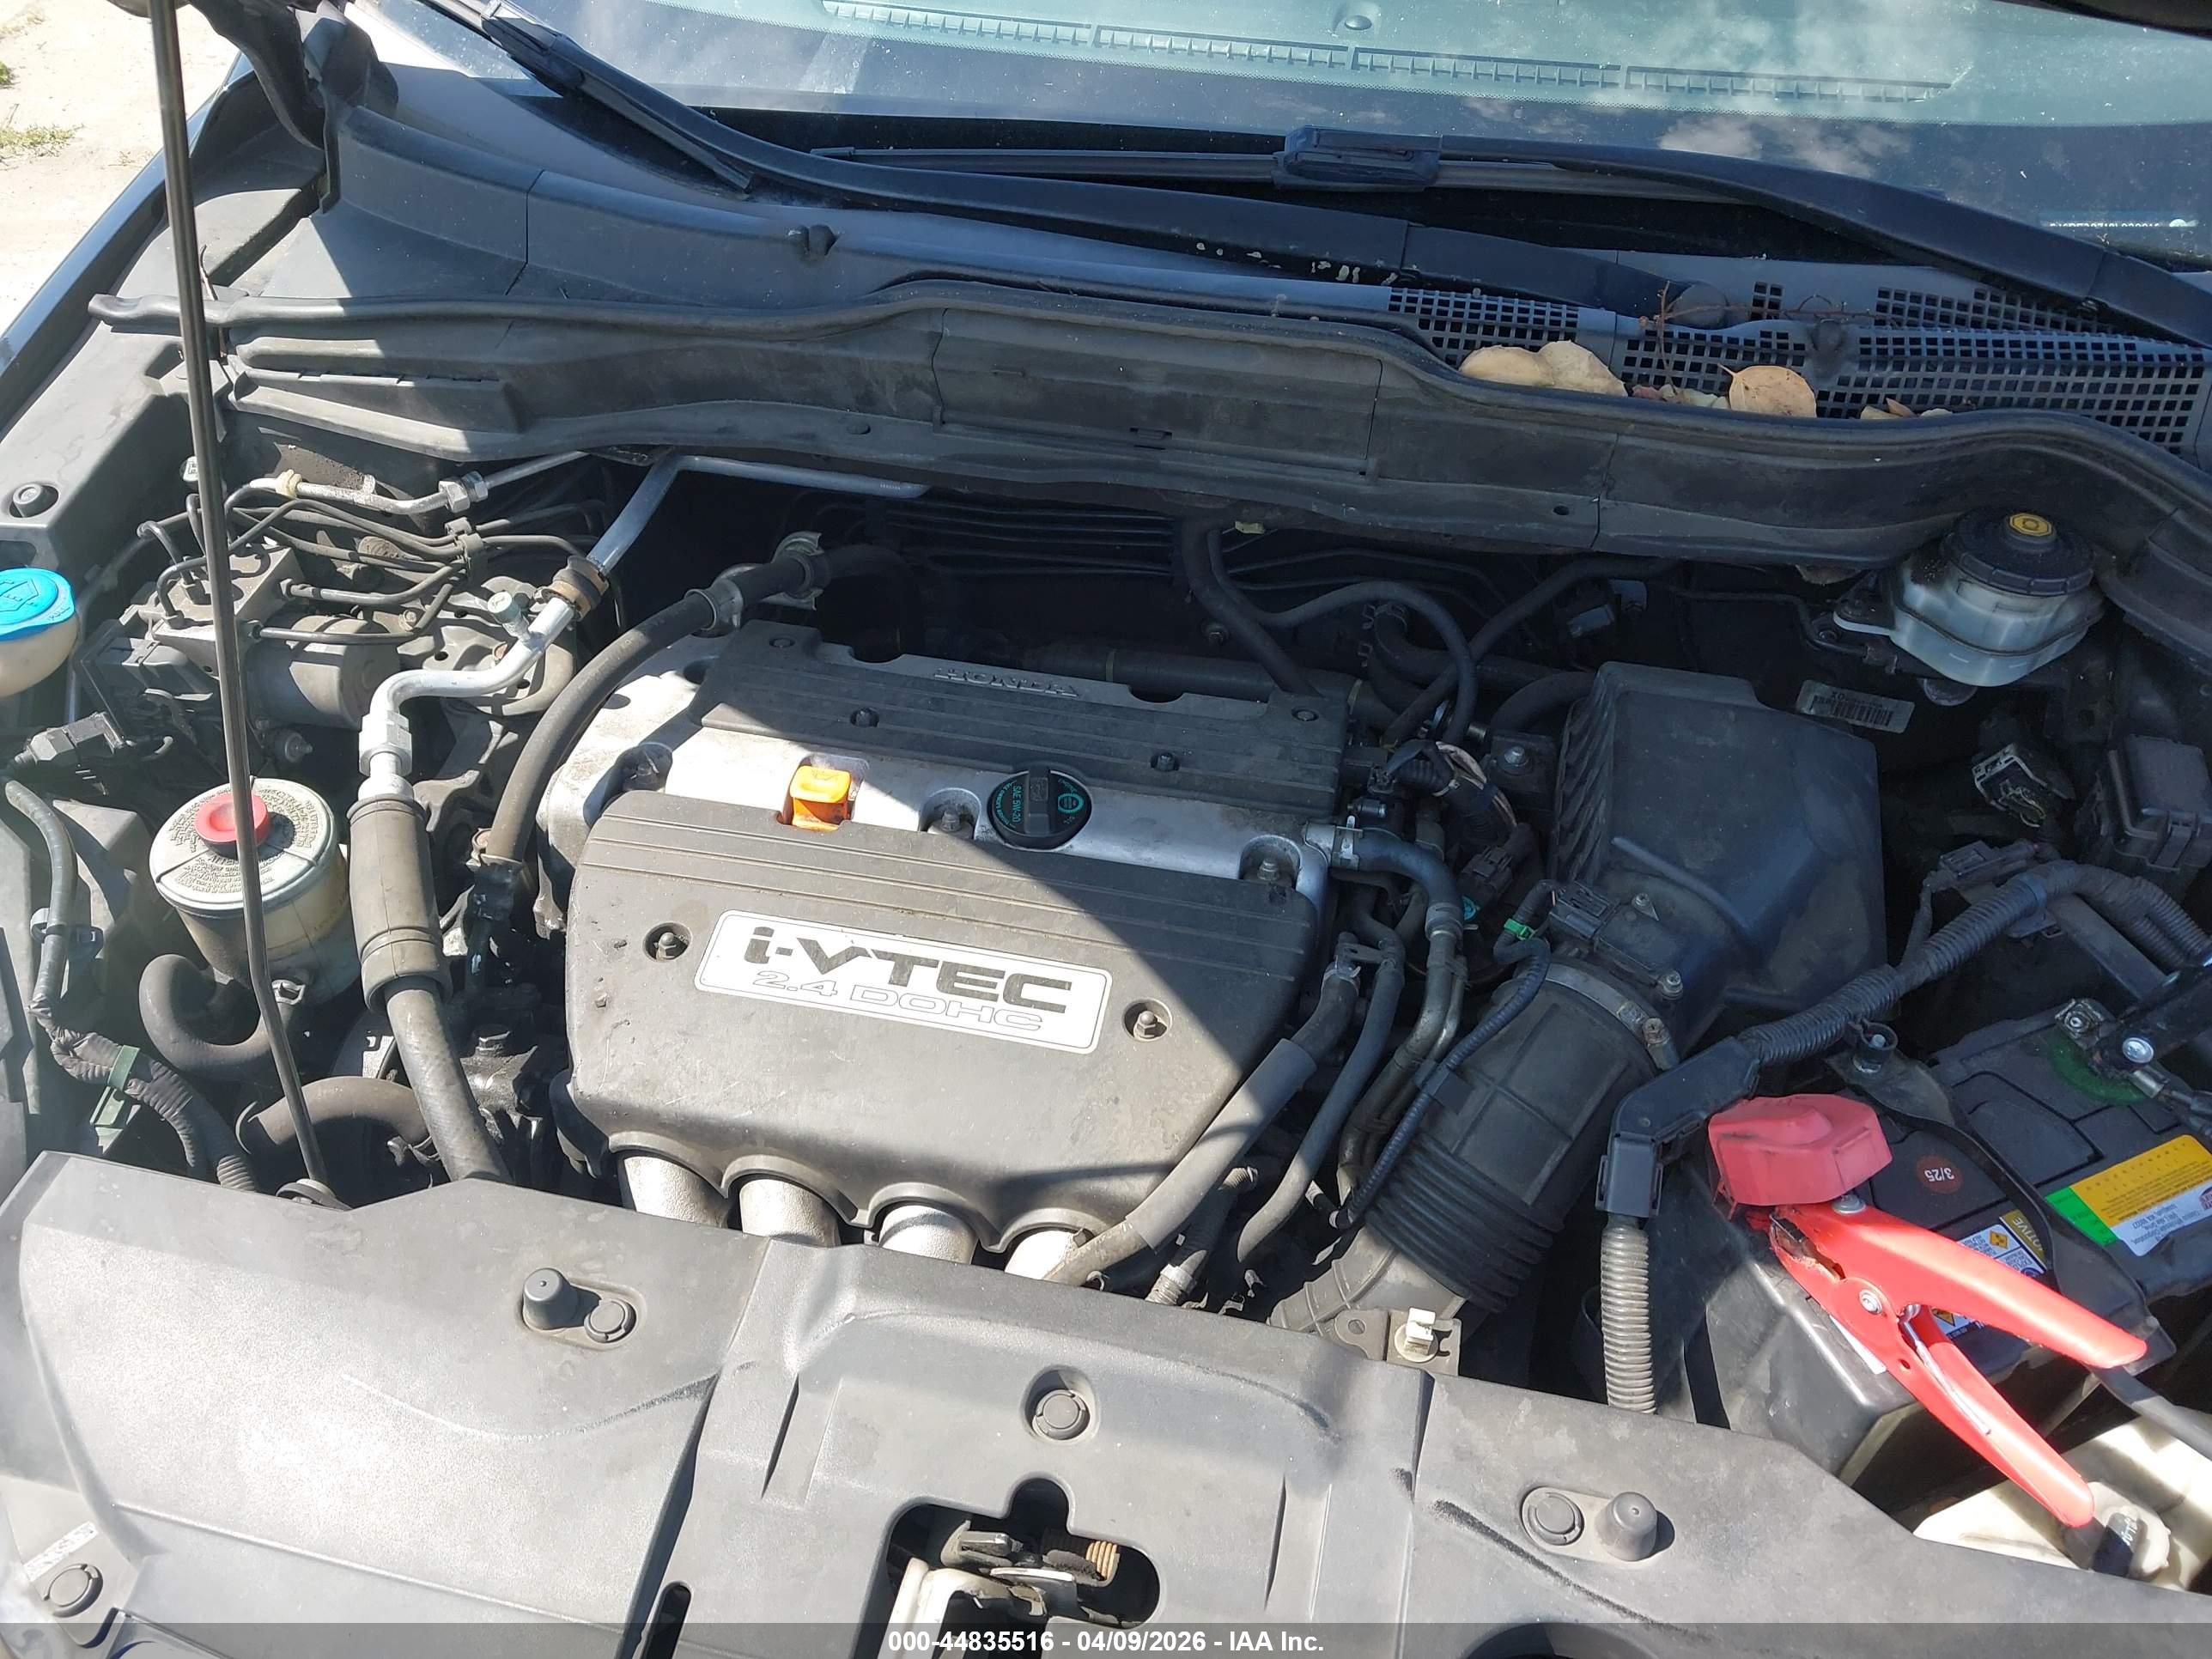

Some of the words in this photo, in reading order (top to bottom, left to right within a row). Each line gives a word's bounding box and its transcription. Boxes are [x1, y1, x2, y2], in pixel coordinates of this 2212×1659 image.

[934, 667, 1079, 697] HONDA
[1012, 785, 1022, 799] SAE
[1012, 799, 1022, 823] 5W-20
[744, 926, 1073, 1014] i-VTEC
[752, 970, 838, 996] 2.4
[850, 984, 1043, 1030] DOHC
[1924, 1167, 1954, 1182] 3/25
